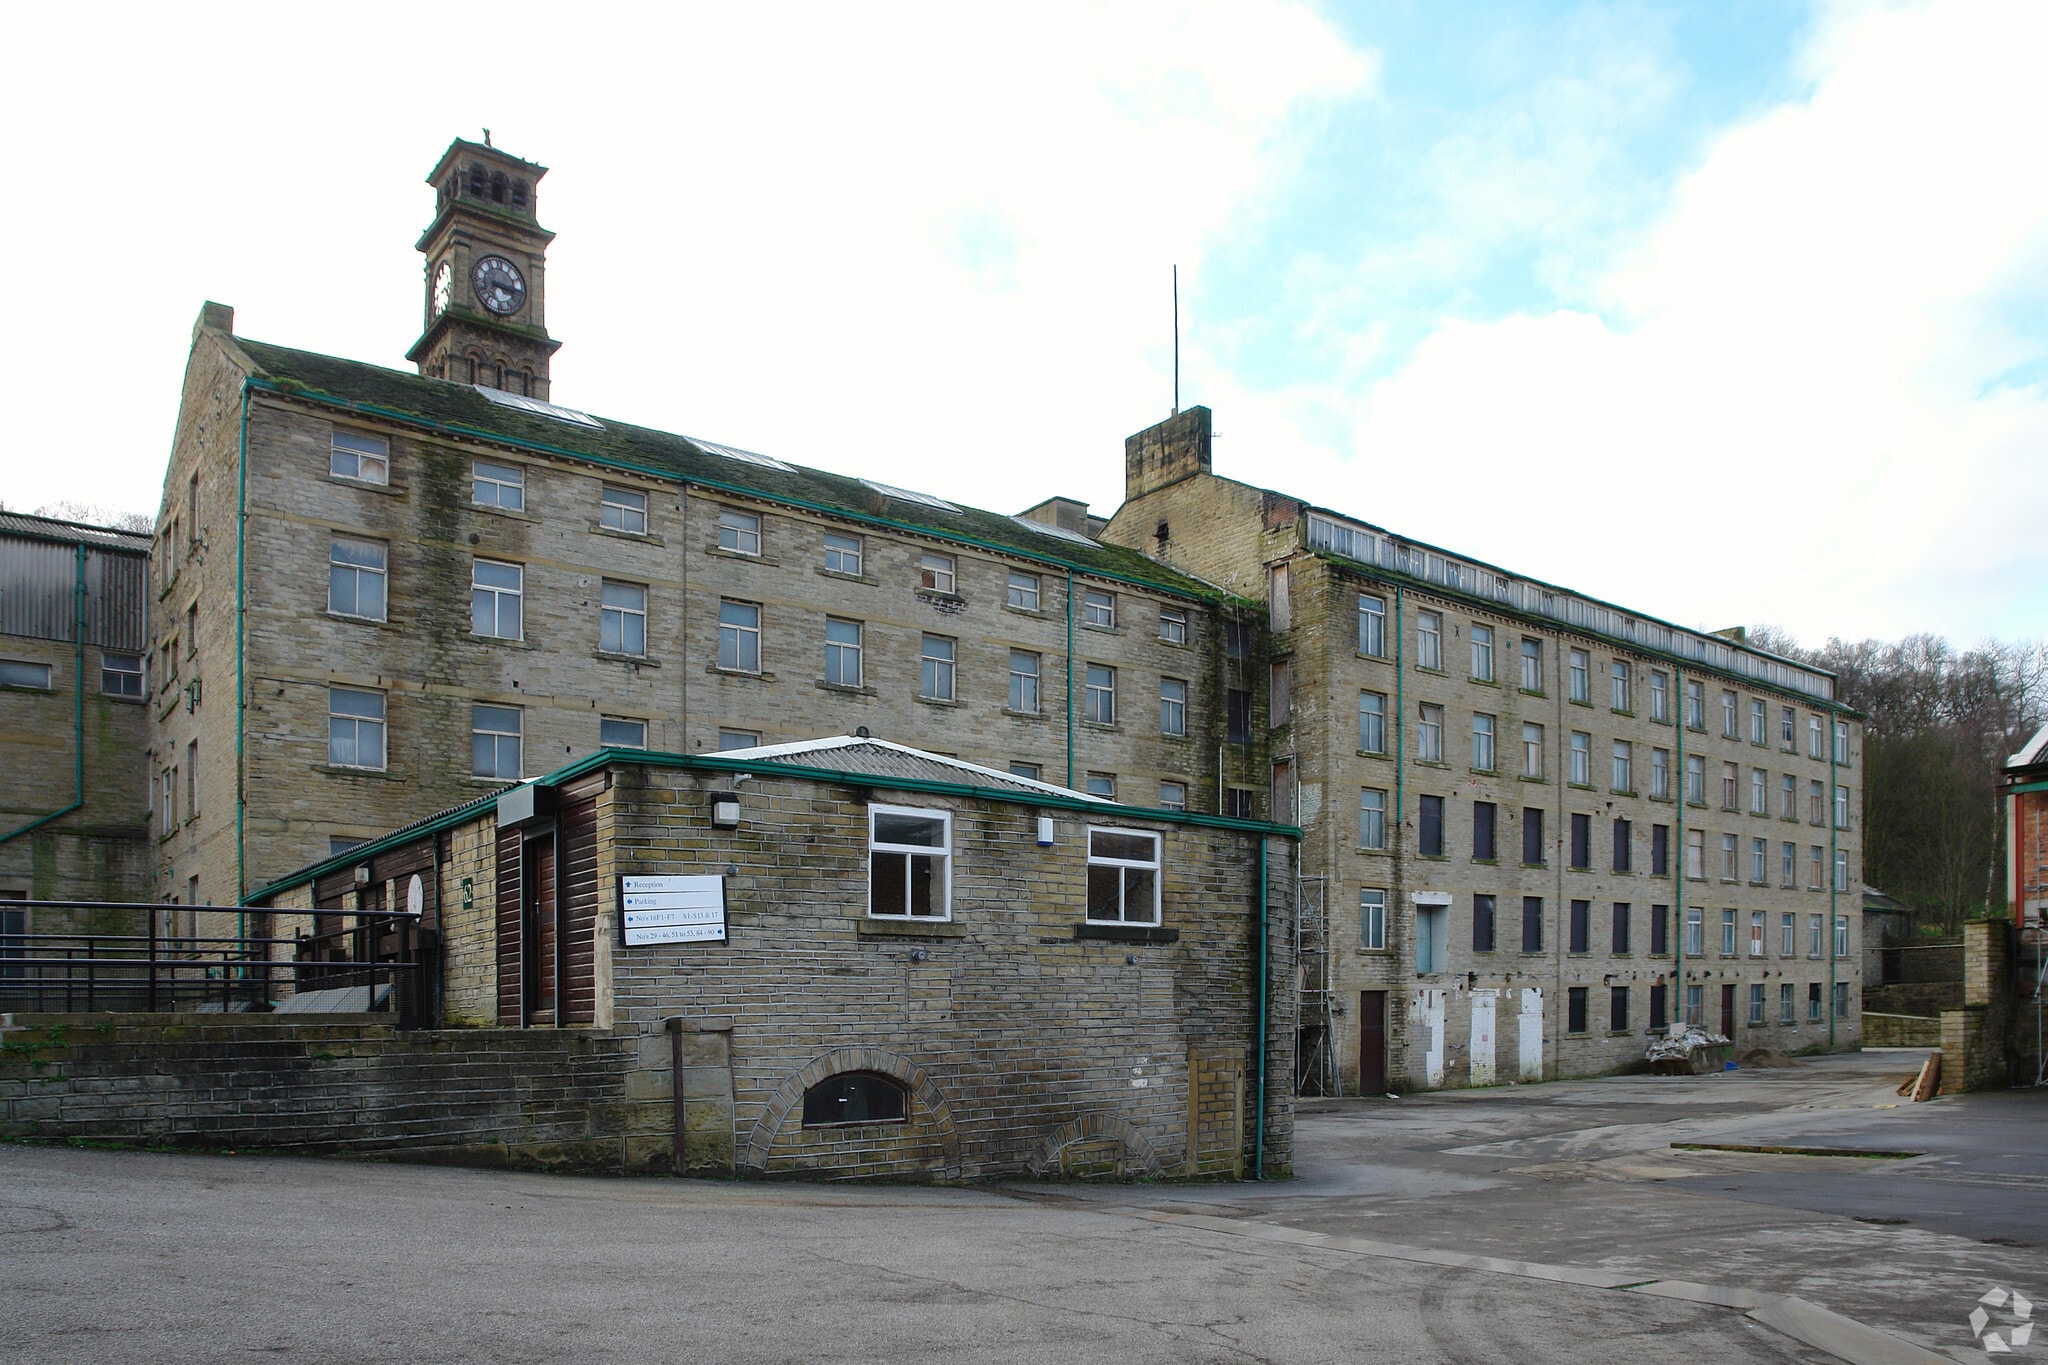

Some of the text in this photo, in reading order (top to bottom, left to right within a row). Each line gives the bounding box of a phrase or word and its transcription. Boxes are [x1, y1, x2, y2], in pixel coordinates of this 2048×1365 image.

[634, 881, 664, 889] Reception
[463, 883, 472, 903] 62
[634, 898, 657, 906] Parking
